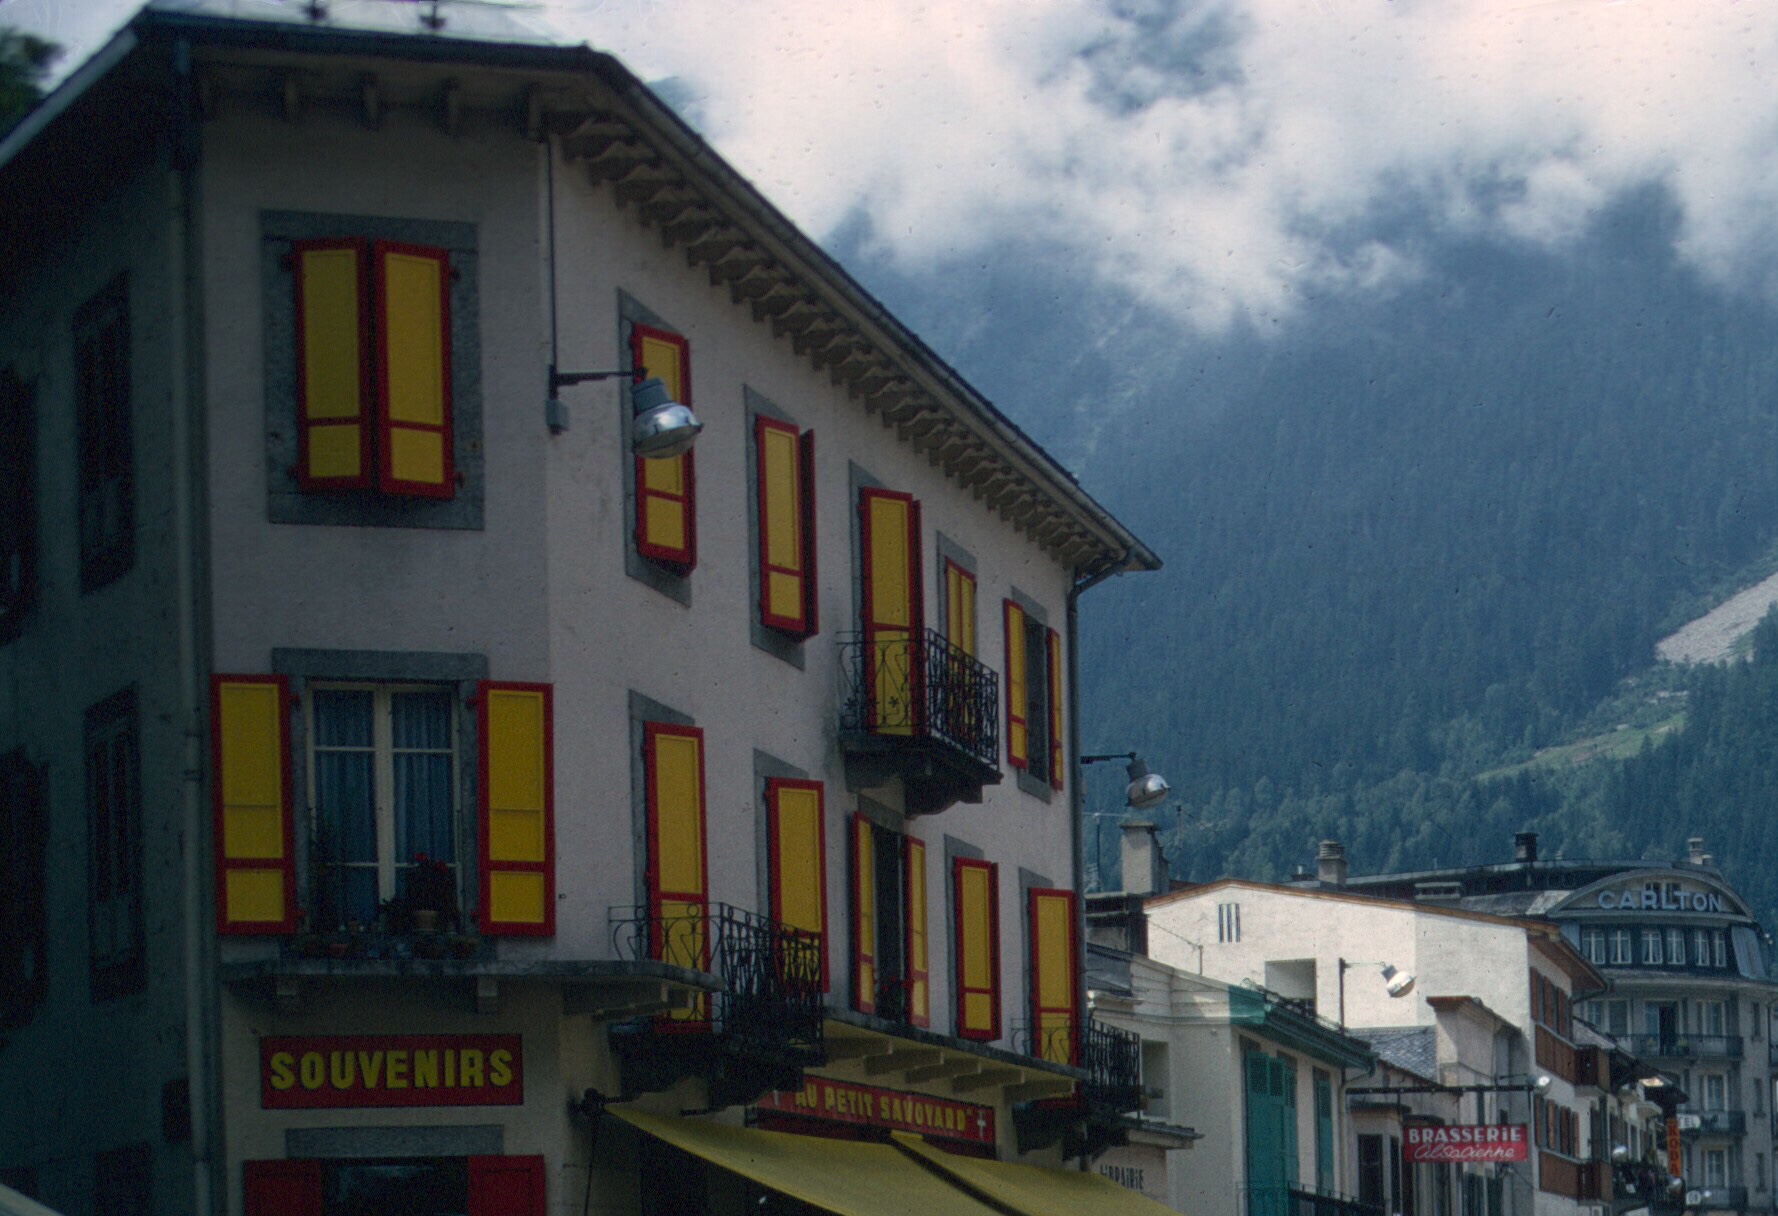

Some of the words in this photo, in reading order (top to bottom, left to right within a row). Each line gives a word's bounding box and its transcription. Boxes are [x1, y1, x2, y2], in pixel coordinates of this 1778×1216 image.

[1598, 884, 1722, 912] CARLTON
[269, 1048, 514, 1091] SOUVENIRS
[795, 1084, 818, 1110] AU
[824, 1087, 874, 1118] PETIT
